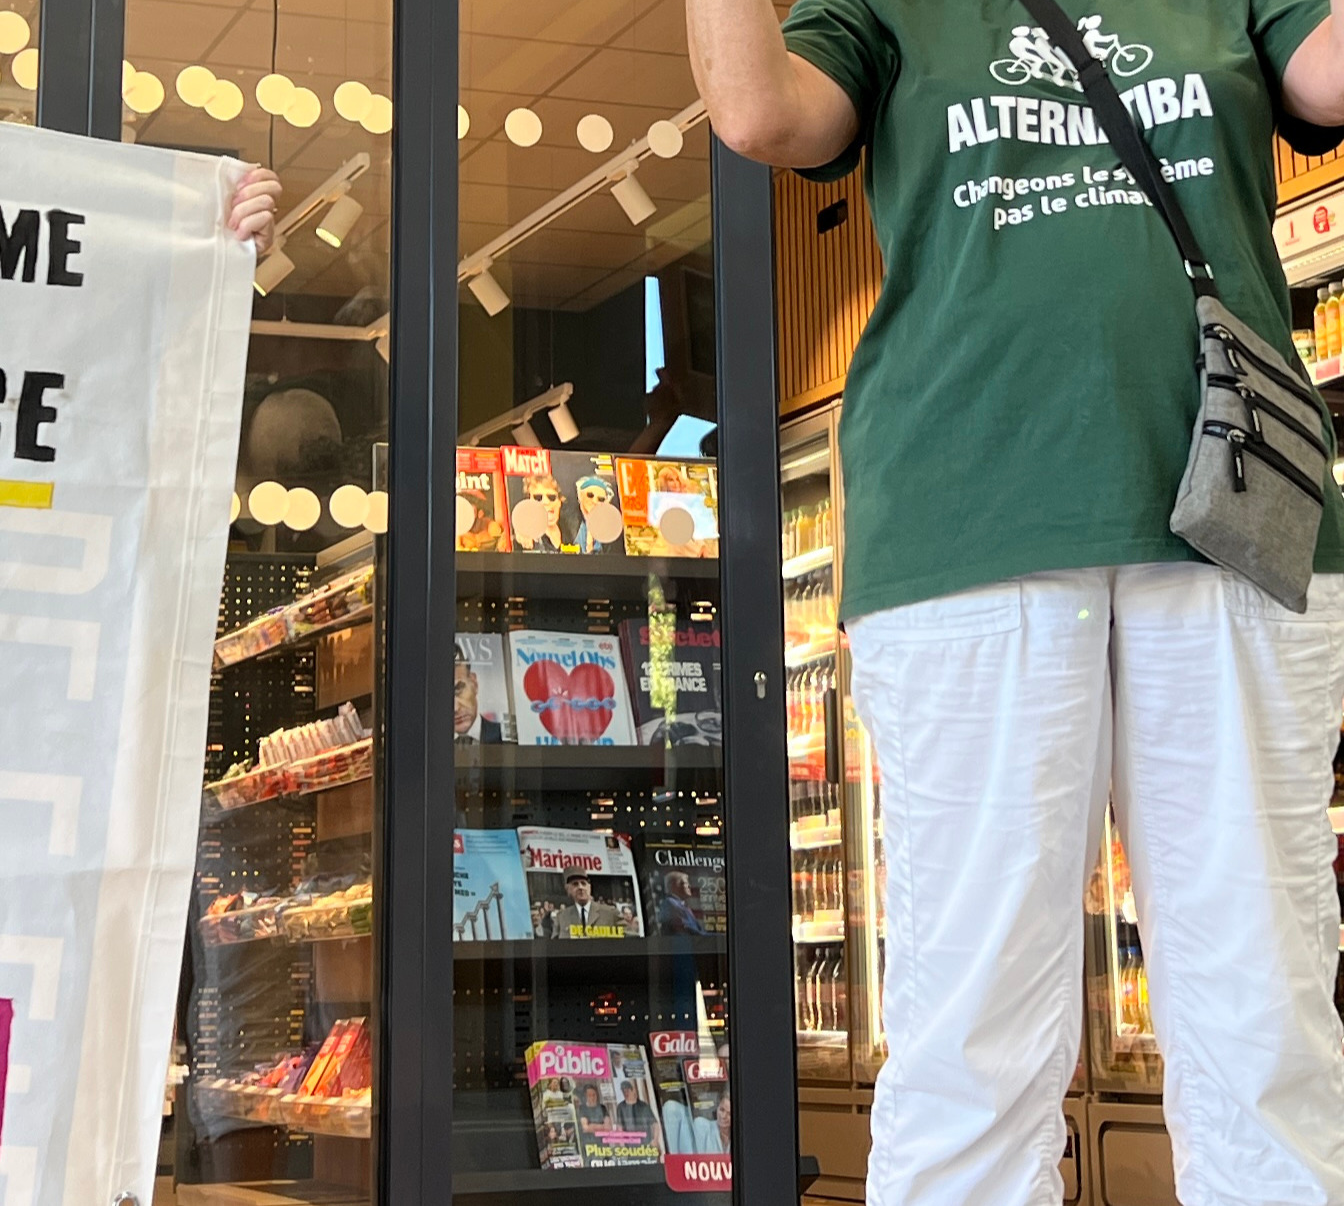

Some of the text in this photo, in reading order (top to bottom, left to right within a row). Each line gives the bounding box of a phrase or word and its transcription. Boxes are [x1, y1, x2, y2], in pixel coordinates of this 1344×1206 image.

[953, 172, 1075, 208] Changeons
[1082, 165, 1109, 185] le
[993, 203, 1034, 230] pas
[1041, 195, 1067, 216] le
[504, 447, 549, 474] MATCH
[516, 648, 616, 669] Nouvel Obs
[530, 848, 602, 871] Marianne
[570, 925, 624, 937] DE GAULLE
[653, 1033, 697, 1054] Gala
[540, 1050, 605, 1076] Public
[585, 1144, 659, 1158] Plus soudés
